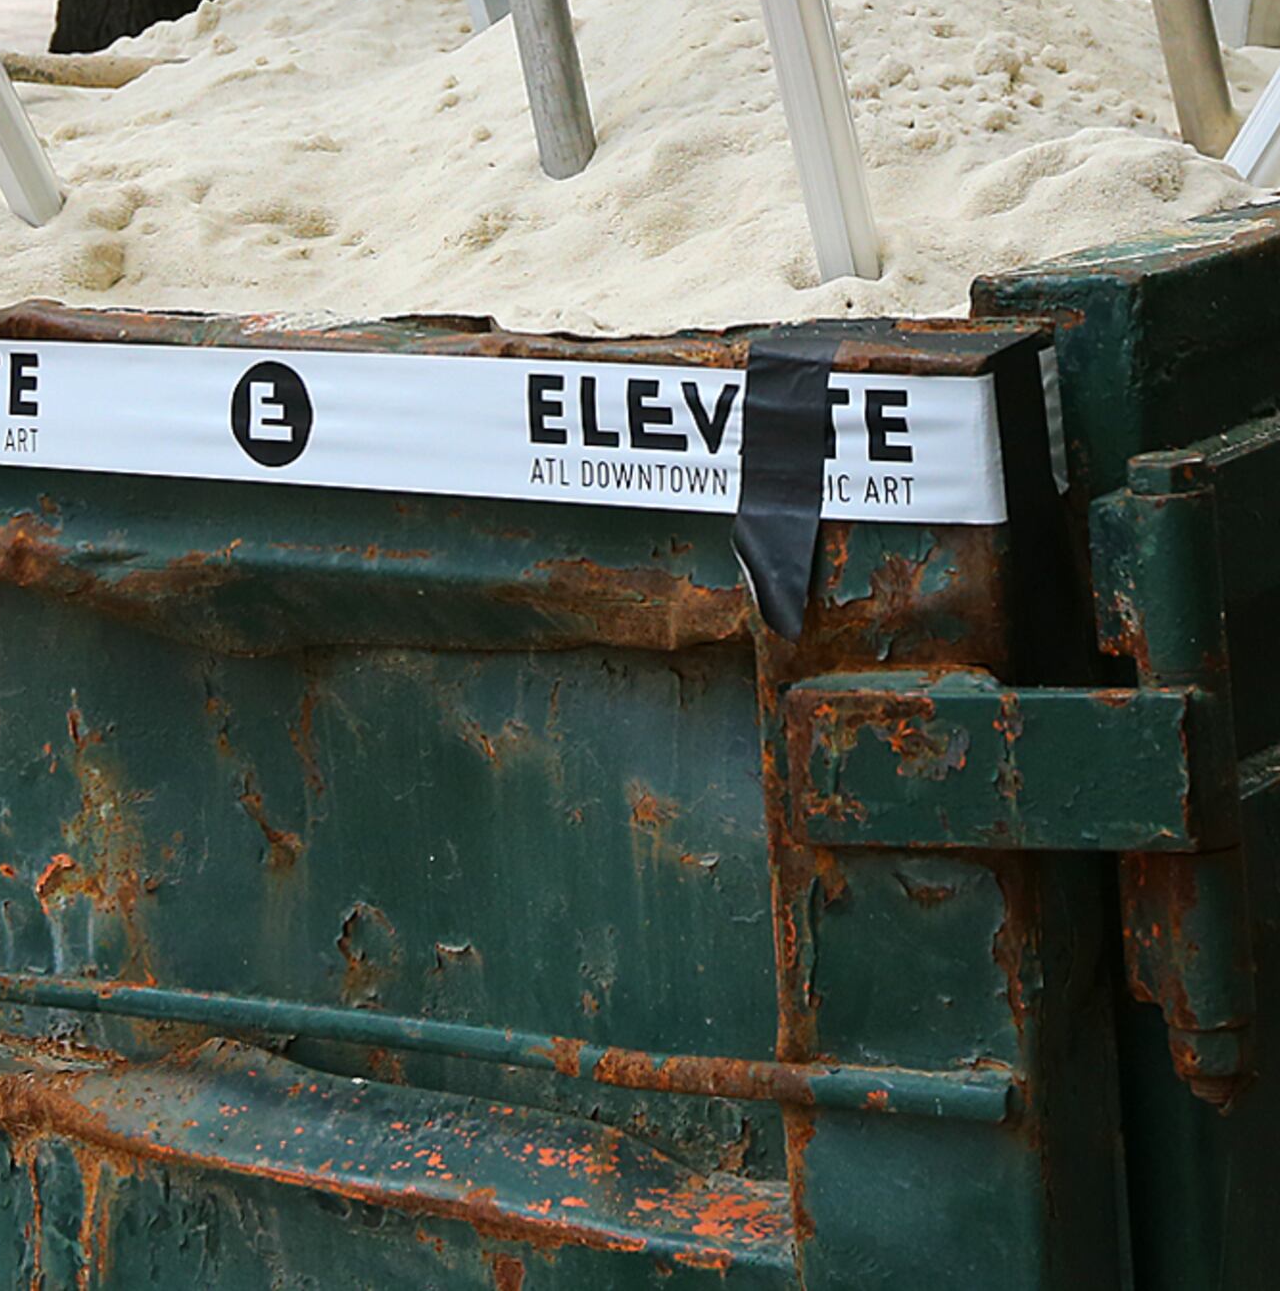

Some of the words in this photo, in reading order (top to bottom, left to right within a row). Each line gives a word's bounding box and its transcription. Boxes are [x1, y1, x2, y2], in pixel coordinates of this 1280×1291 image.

[4, 428, 39, 453] ART
[527, 374, 913, 463] ELEVTE
[531, 458, 570, 487] ATL
[581, 461, 727, 496] DOWNTOWN
[864, 476, 915, 506] ART
